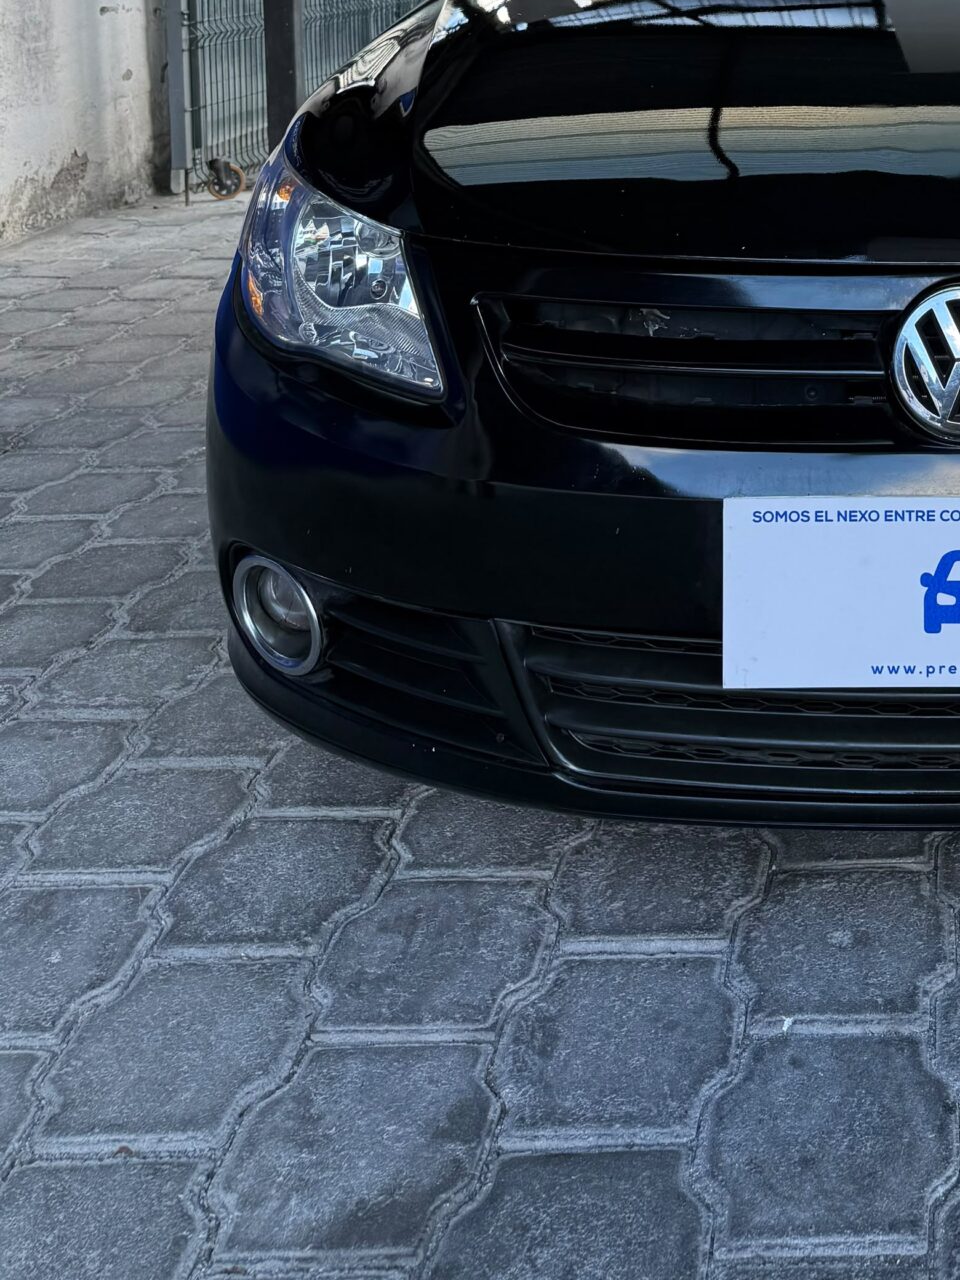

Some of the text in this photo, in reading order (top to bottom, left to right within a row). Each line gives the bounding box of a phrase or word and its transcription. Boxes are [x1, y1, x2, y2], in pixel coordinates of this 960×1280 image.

[752, 510, 811, 523] SOMOS
[814, 510, 834, 523] EL
[836, 510, 880, 522] NEXO
[884, 510, 936, 522] ENTRE
